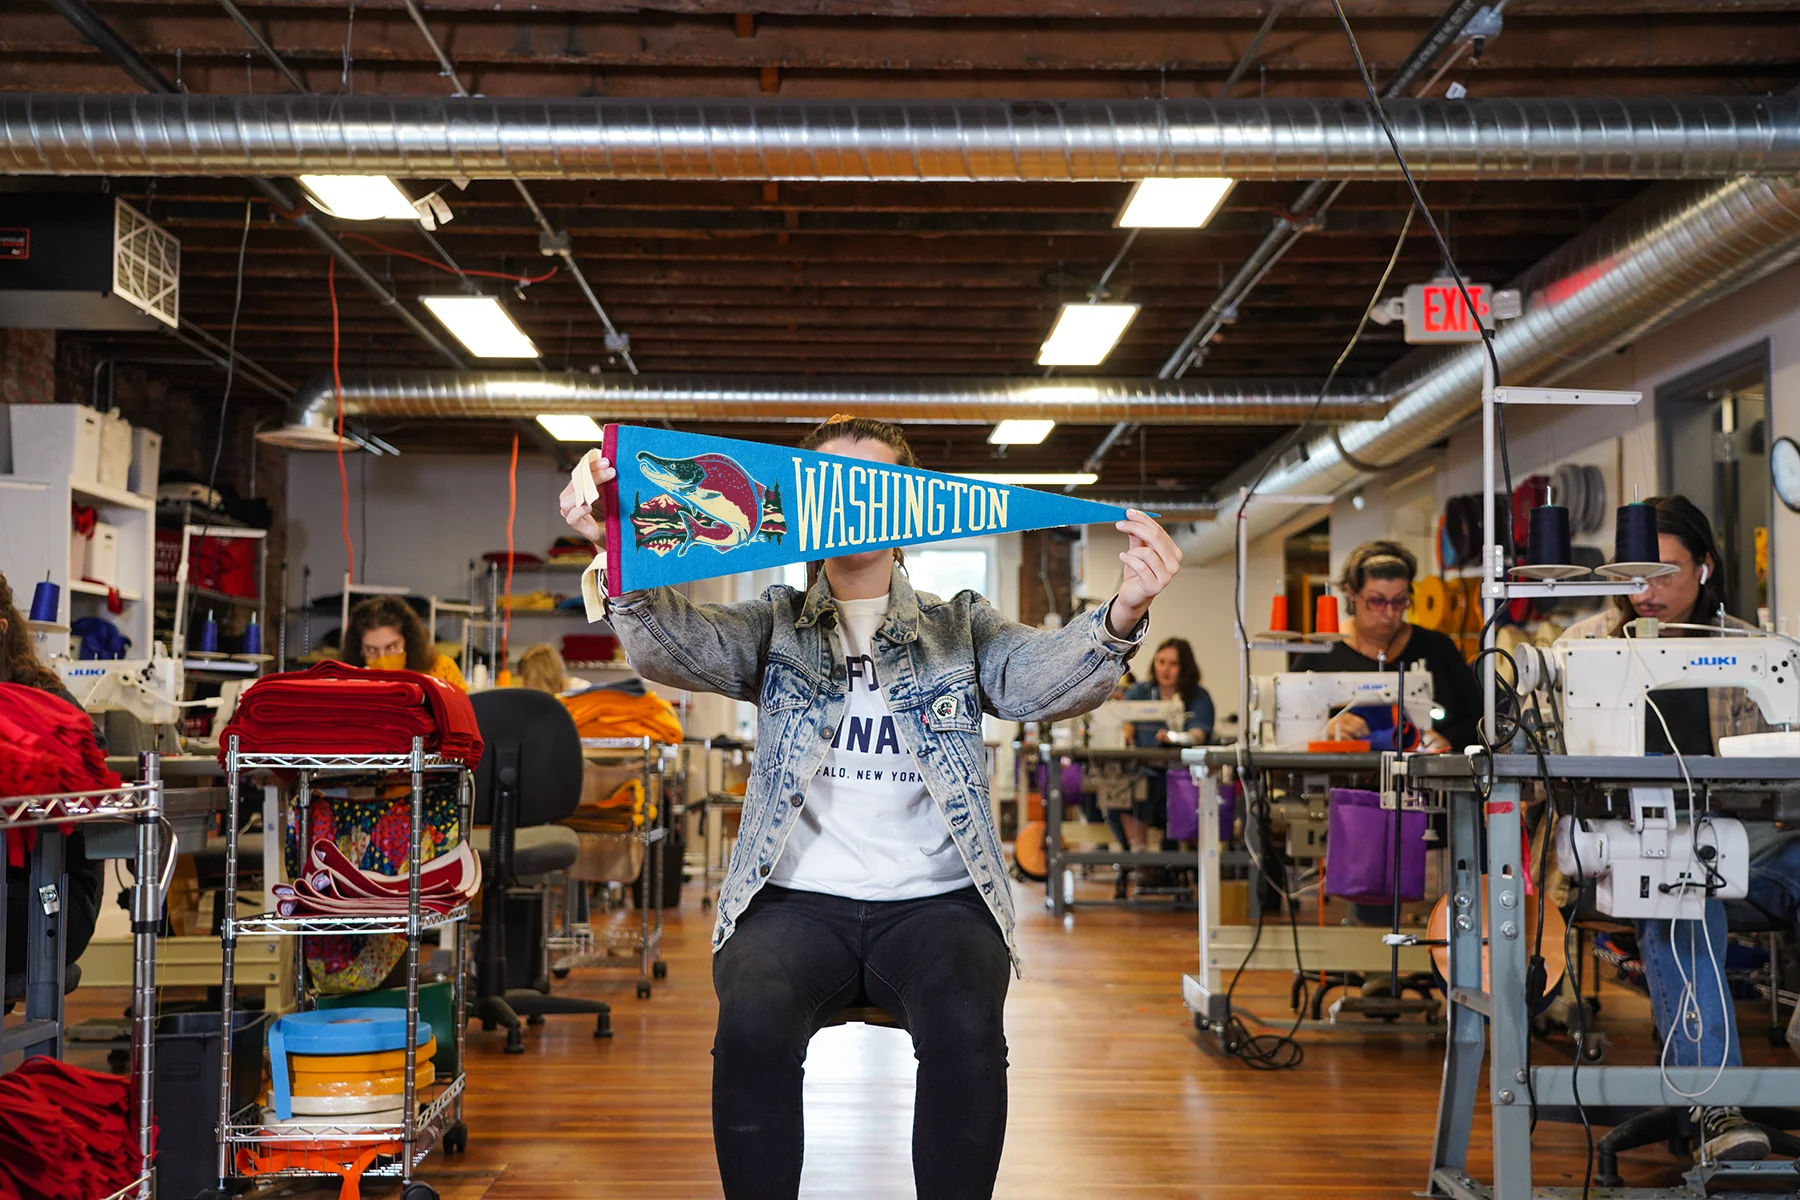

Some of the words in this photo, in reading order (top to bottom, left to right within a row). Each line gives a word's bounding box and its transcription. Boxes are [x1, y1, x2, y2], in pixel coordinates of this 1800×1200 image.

[1423, 286, 1484, 332] EXIT
[792, 457, 1010, 552] WASHINGTON
[1689, 656, 1737, 666] JUKI
[67, 668, 106, 677] JUKI
[856, 770, 883, 781] NEW
